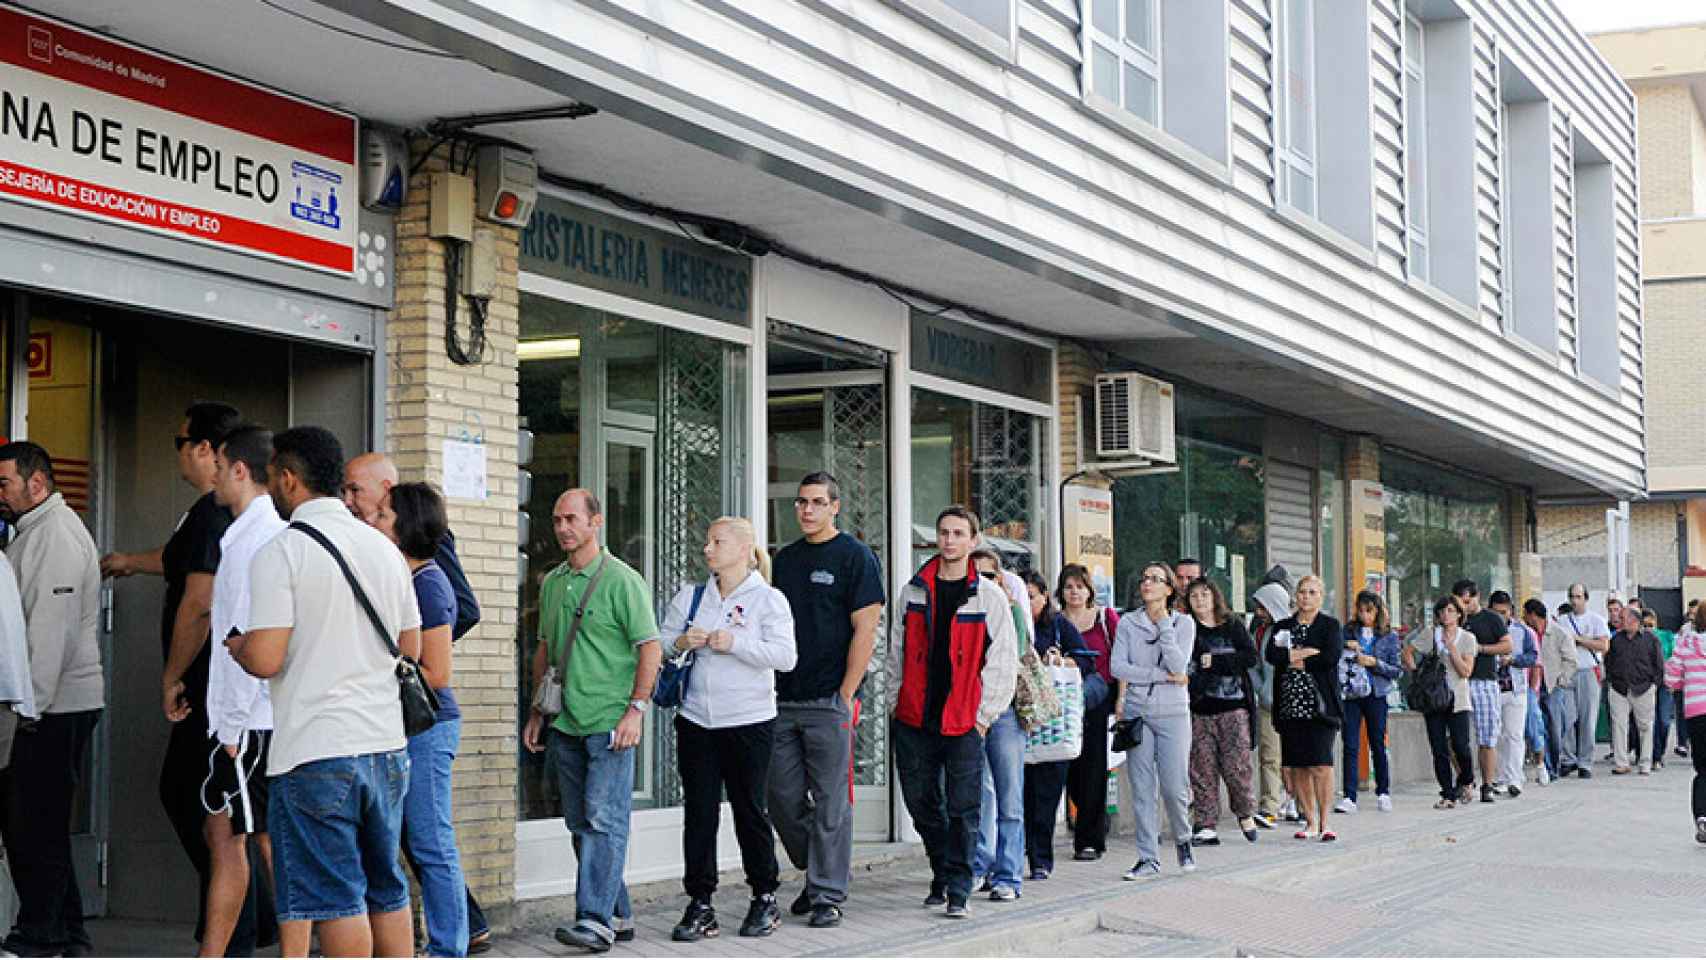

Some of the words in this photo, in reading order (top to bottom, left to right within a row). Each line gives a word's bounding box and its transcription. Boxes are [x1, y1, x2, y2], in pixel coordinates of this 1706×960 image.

[115, 63, 129, 77] de
[131, 66, 166, 88] Madrid
[2, 91, 58, 148] NA
[72, 110, 122, 164] DE
[136, 127, 279, 203] EMPLEO
[58, 182, 77, 201] DE
[80, 187, 157, 220] EDUCACIÓN
[159, 206, 168, 221] Y
[170, 208, 220, 234] EMPLEO
[661, 247, 748, 313] MENESES
